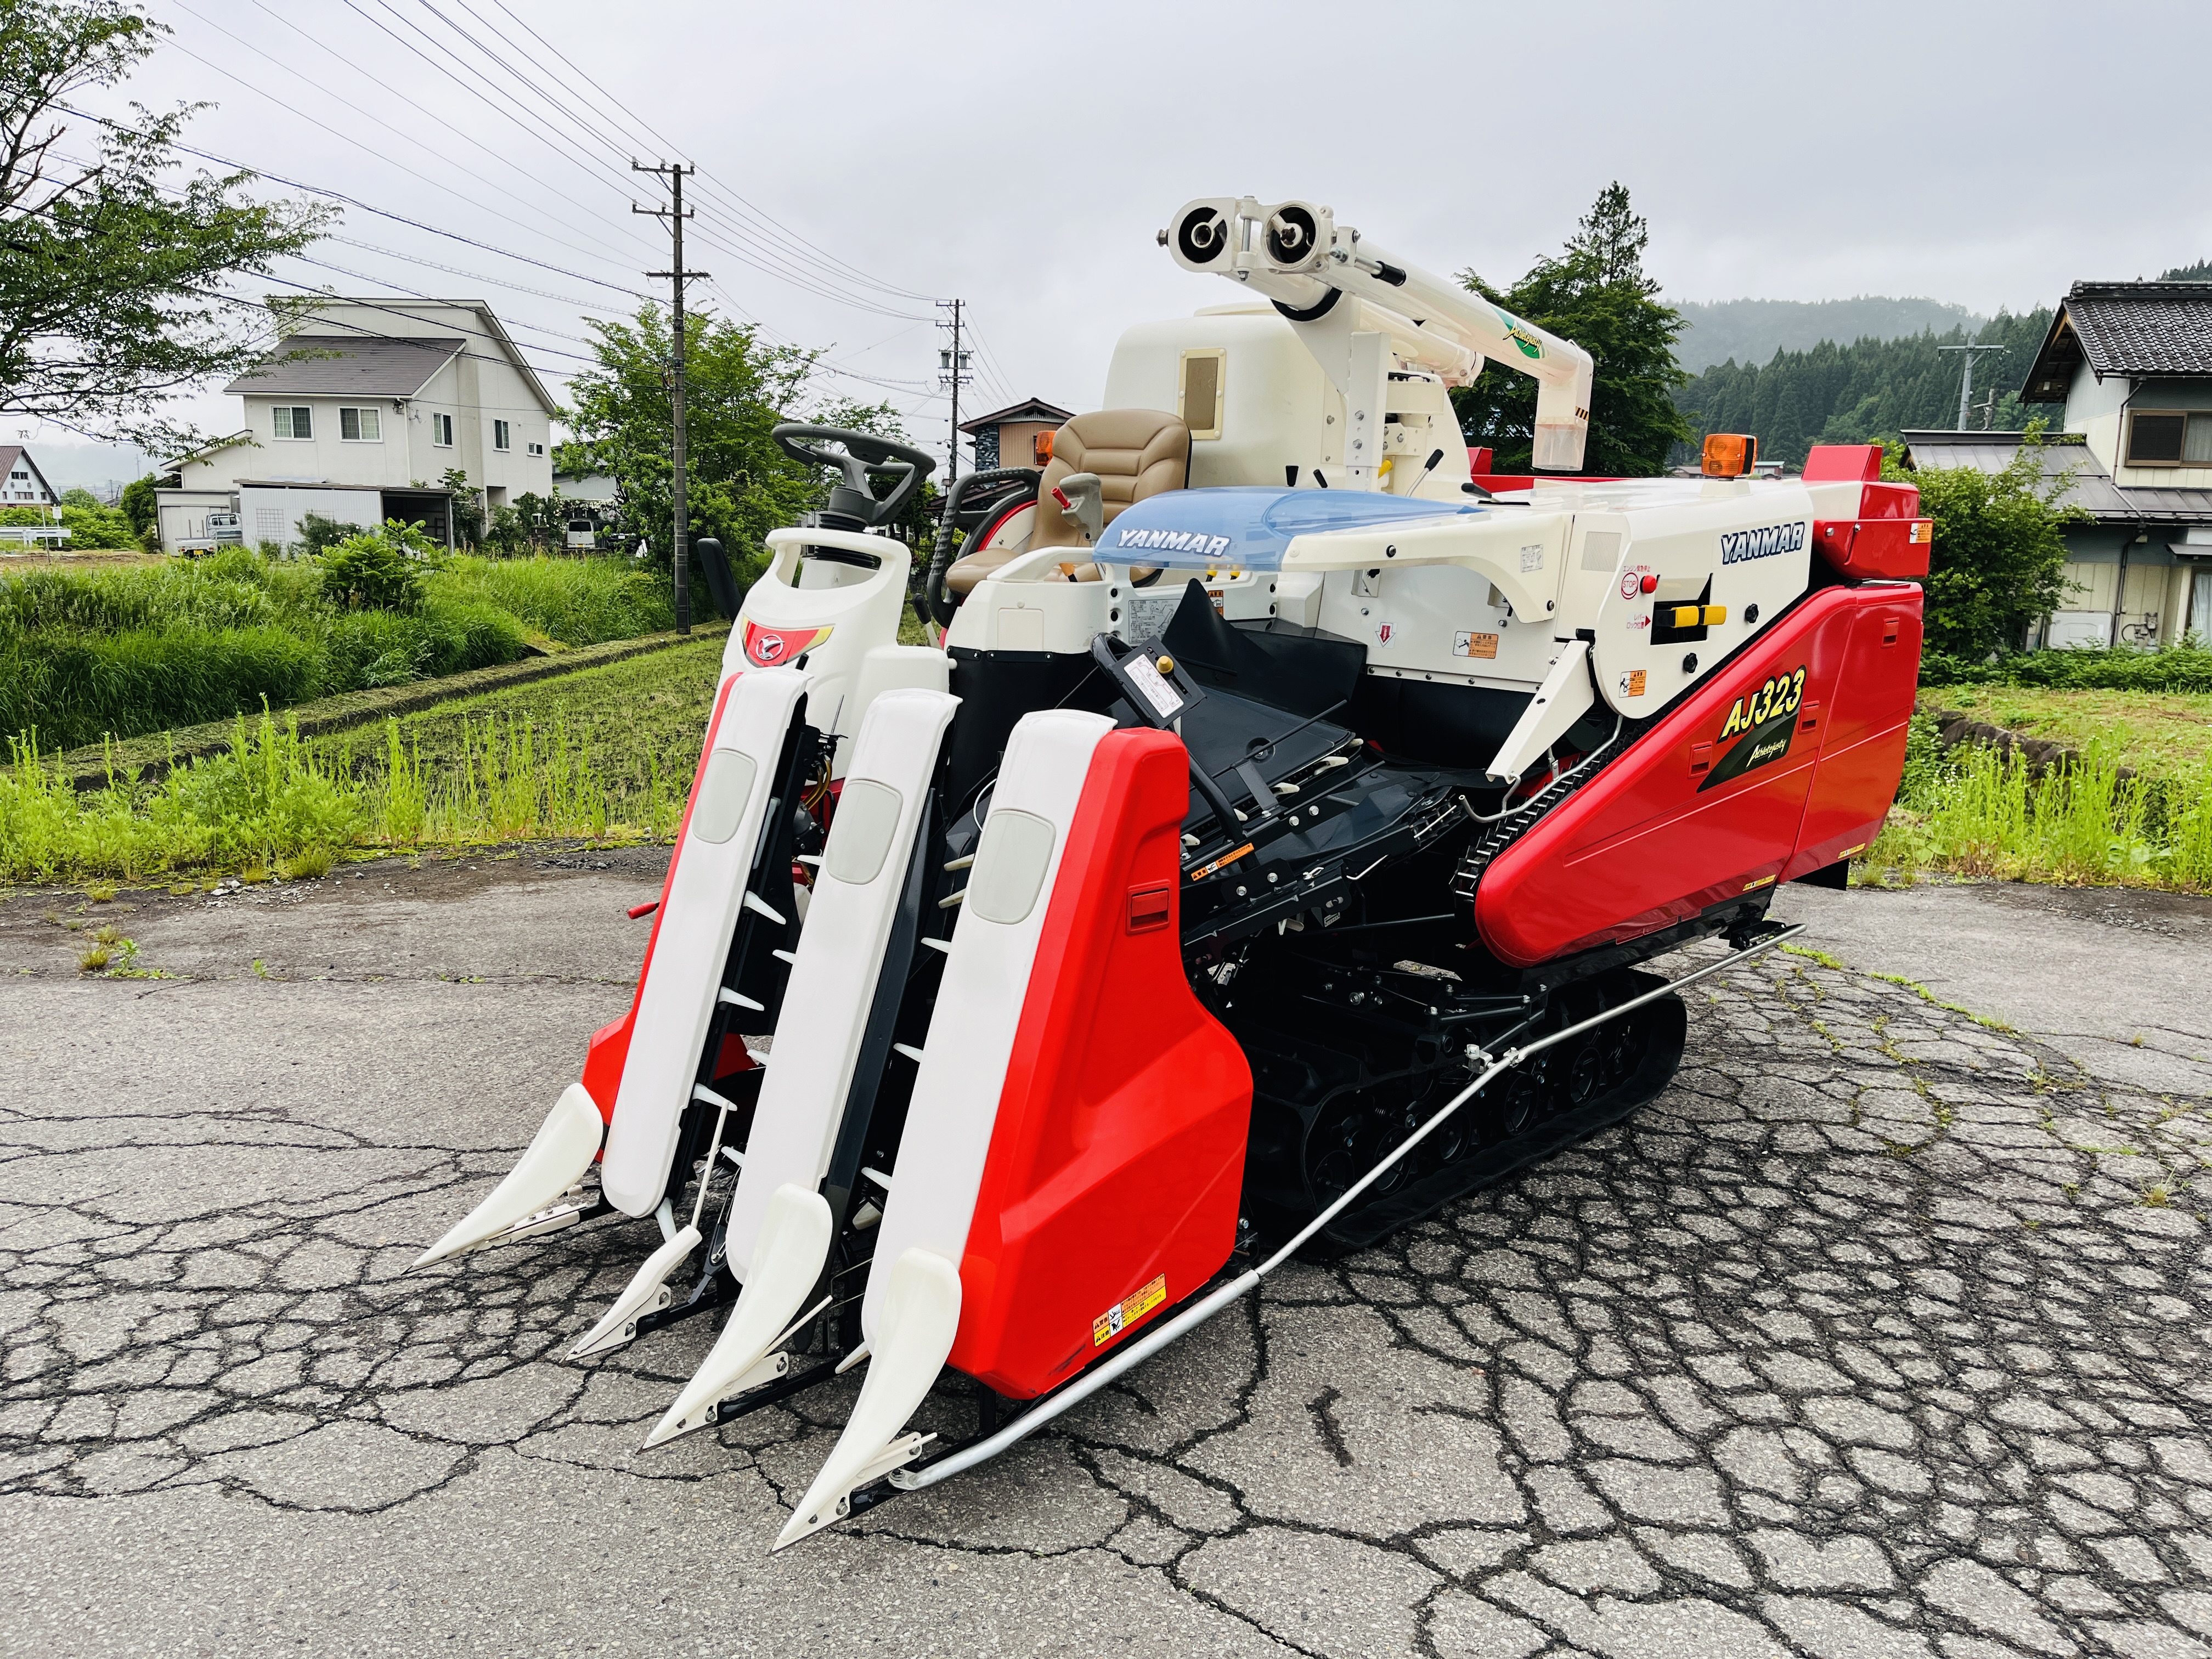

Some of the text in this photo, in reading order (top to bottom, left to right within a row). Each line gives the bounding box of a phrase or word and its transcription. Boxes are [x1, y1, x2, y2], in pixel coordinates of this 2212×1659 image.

[1117, 529, 1231, 557] YANMAR
[1721, 521, 1805, 565] YANMAR
[1717, 665, 1807, 744] AJ323
